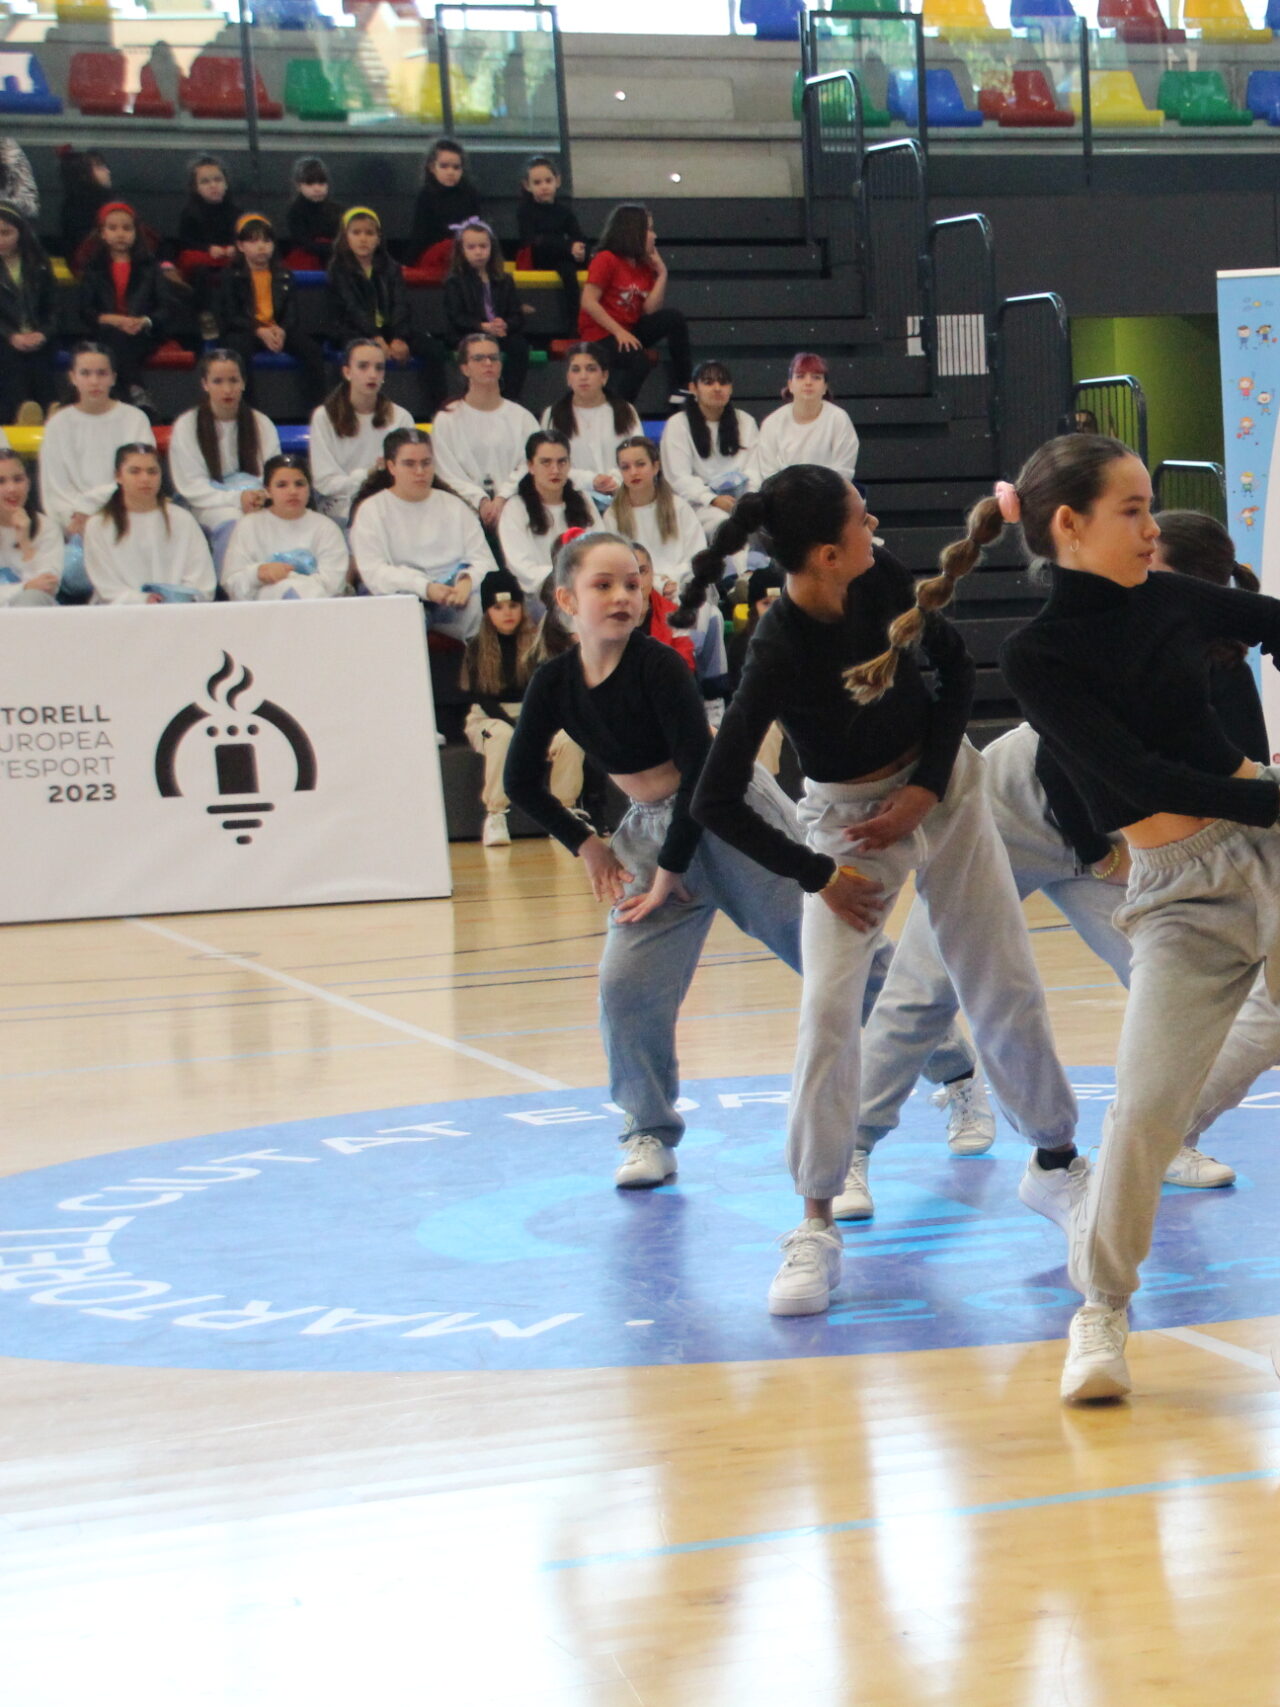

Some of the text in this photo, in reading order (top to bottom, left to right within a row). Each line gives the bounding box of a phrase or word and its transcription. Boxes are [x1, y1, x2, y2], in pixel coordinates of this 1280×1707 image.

[0, 705, 111, 725] TORELL
[48, 783, 117, 803] 2023
[57, 1120, 471, 1211] CIUTAT
[0, 1215, 586, 1338] MARTORELL
